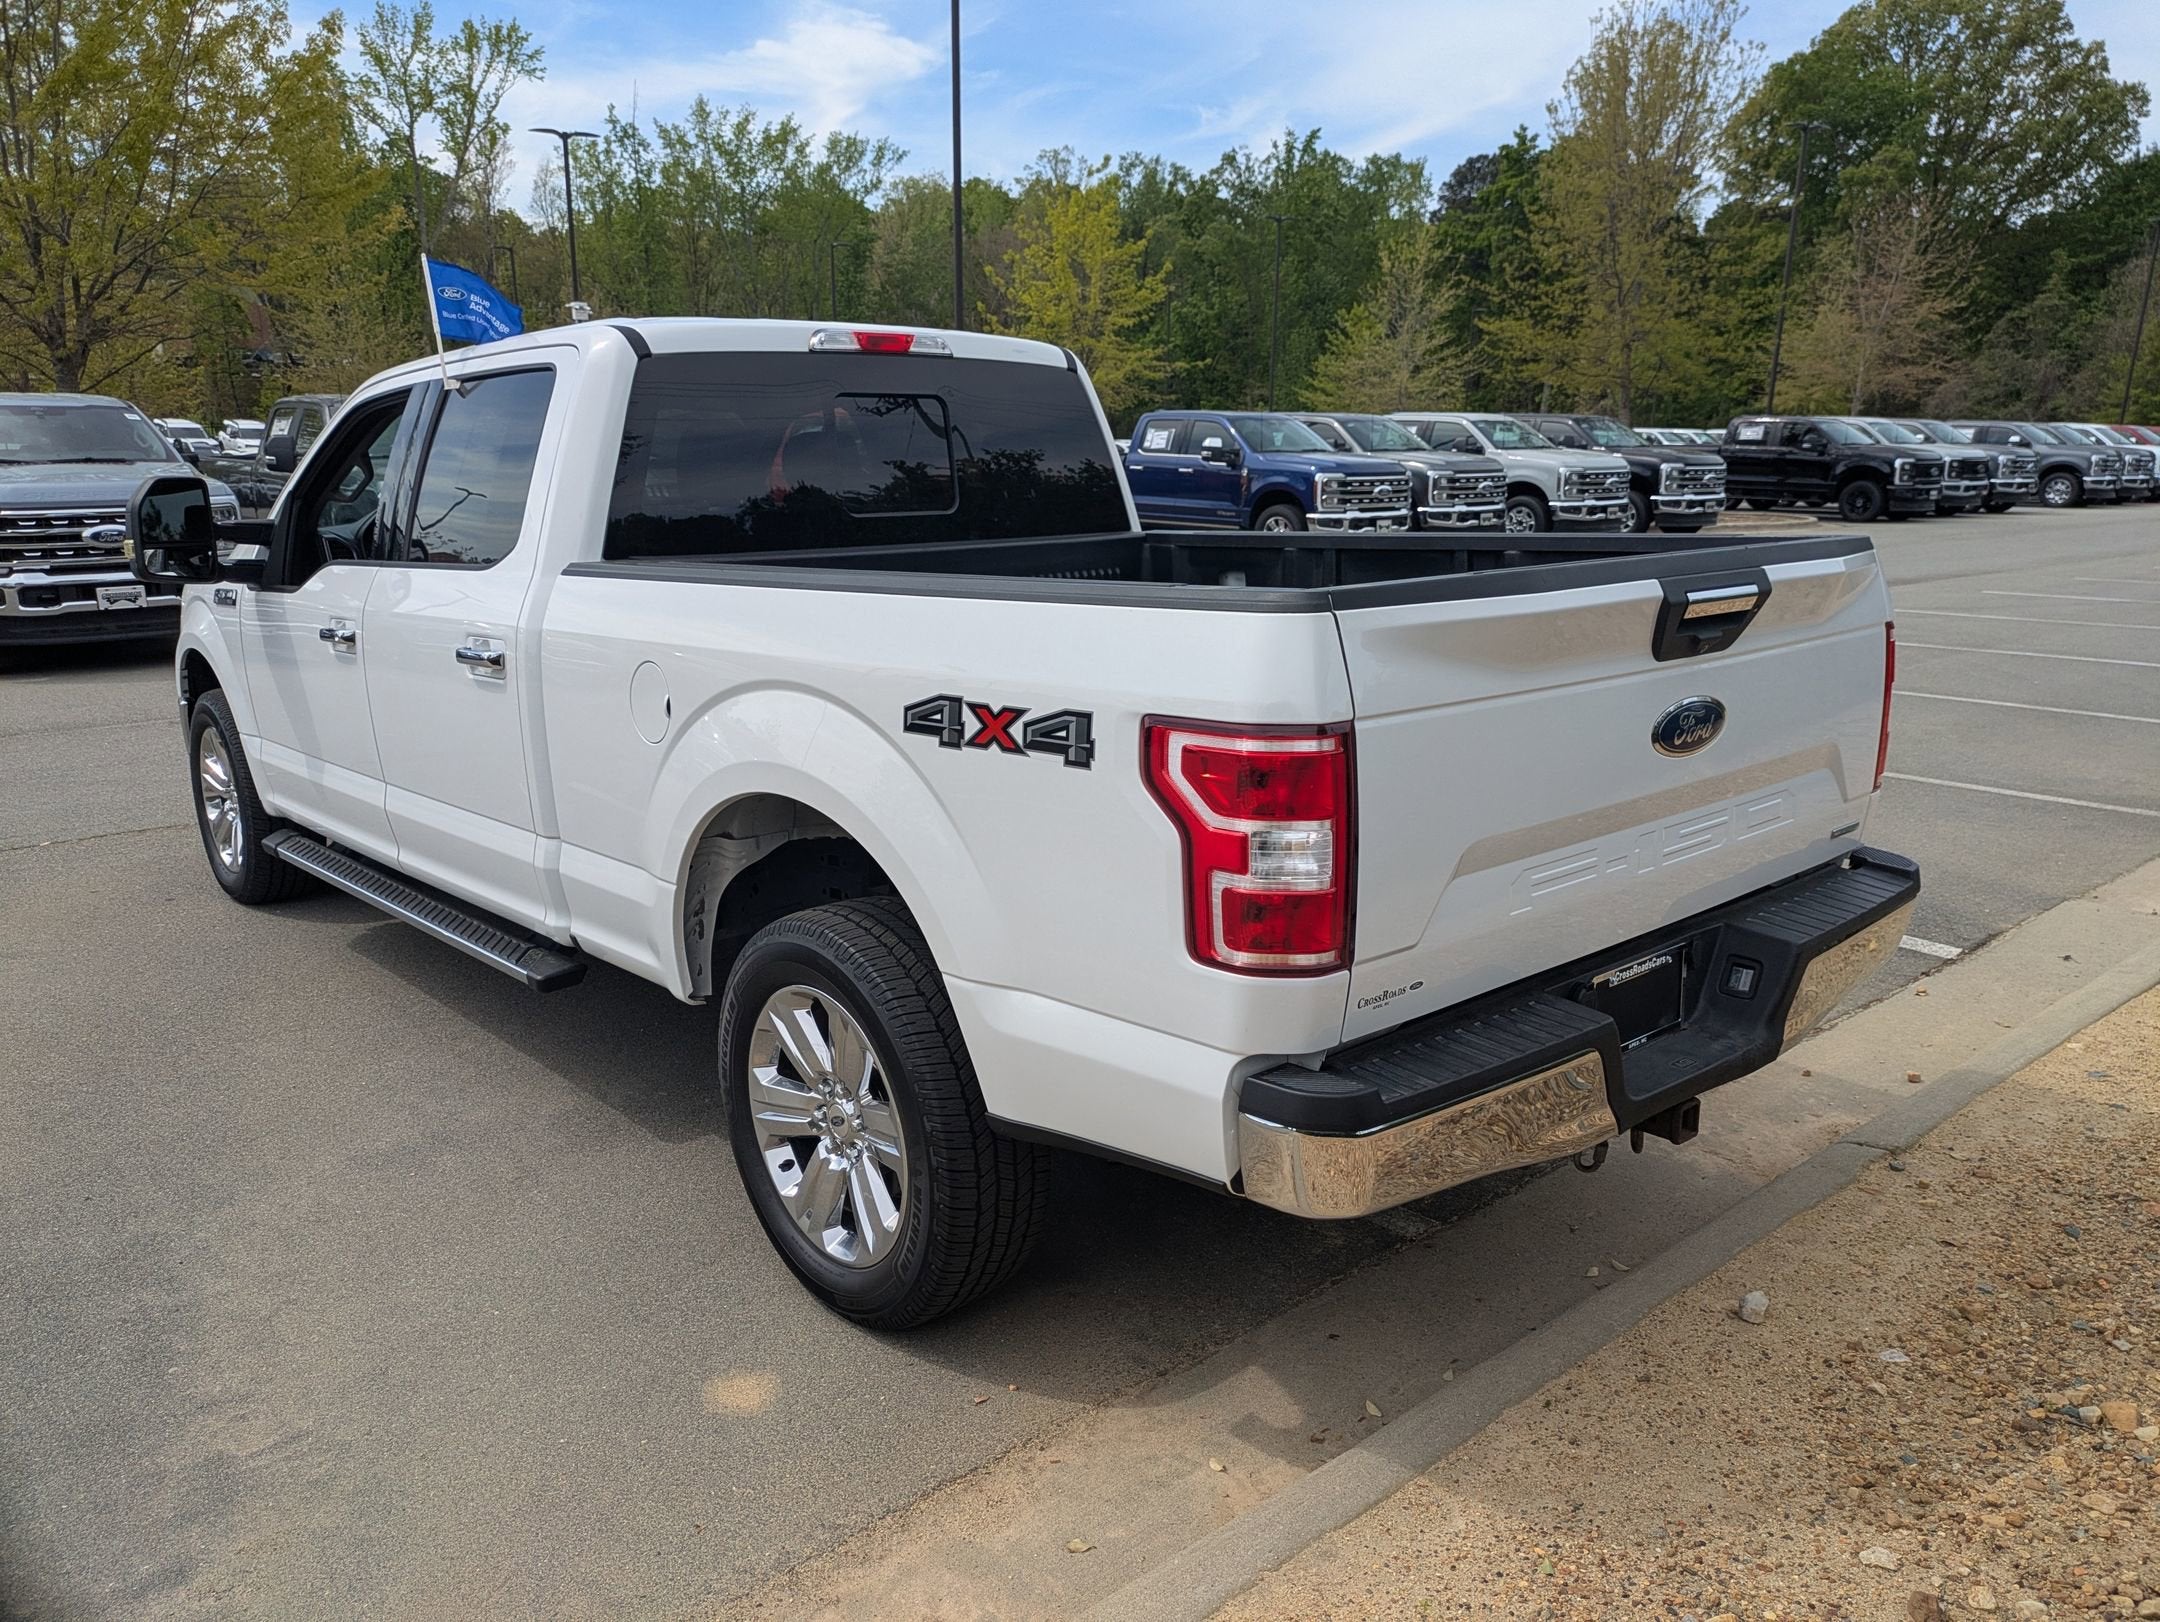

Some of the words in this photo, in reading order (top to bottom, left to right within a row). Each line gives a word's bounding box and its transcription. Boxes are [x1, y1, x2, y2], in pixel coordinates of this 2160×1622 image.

[443, 288, 461, 299] Ford
[470, 294, 491, 309] Blue
[469, 302, 510, 334] Advantage
[1674, 708, 1716, 746] Ford
[1508, 788, 1797, 916] F-150
